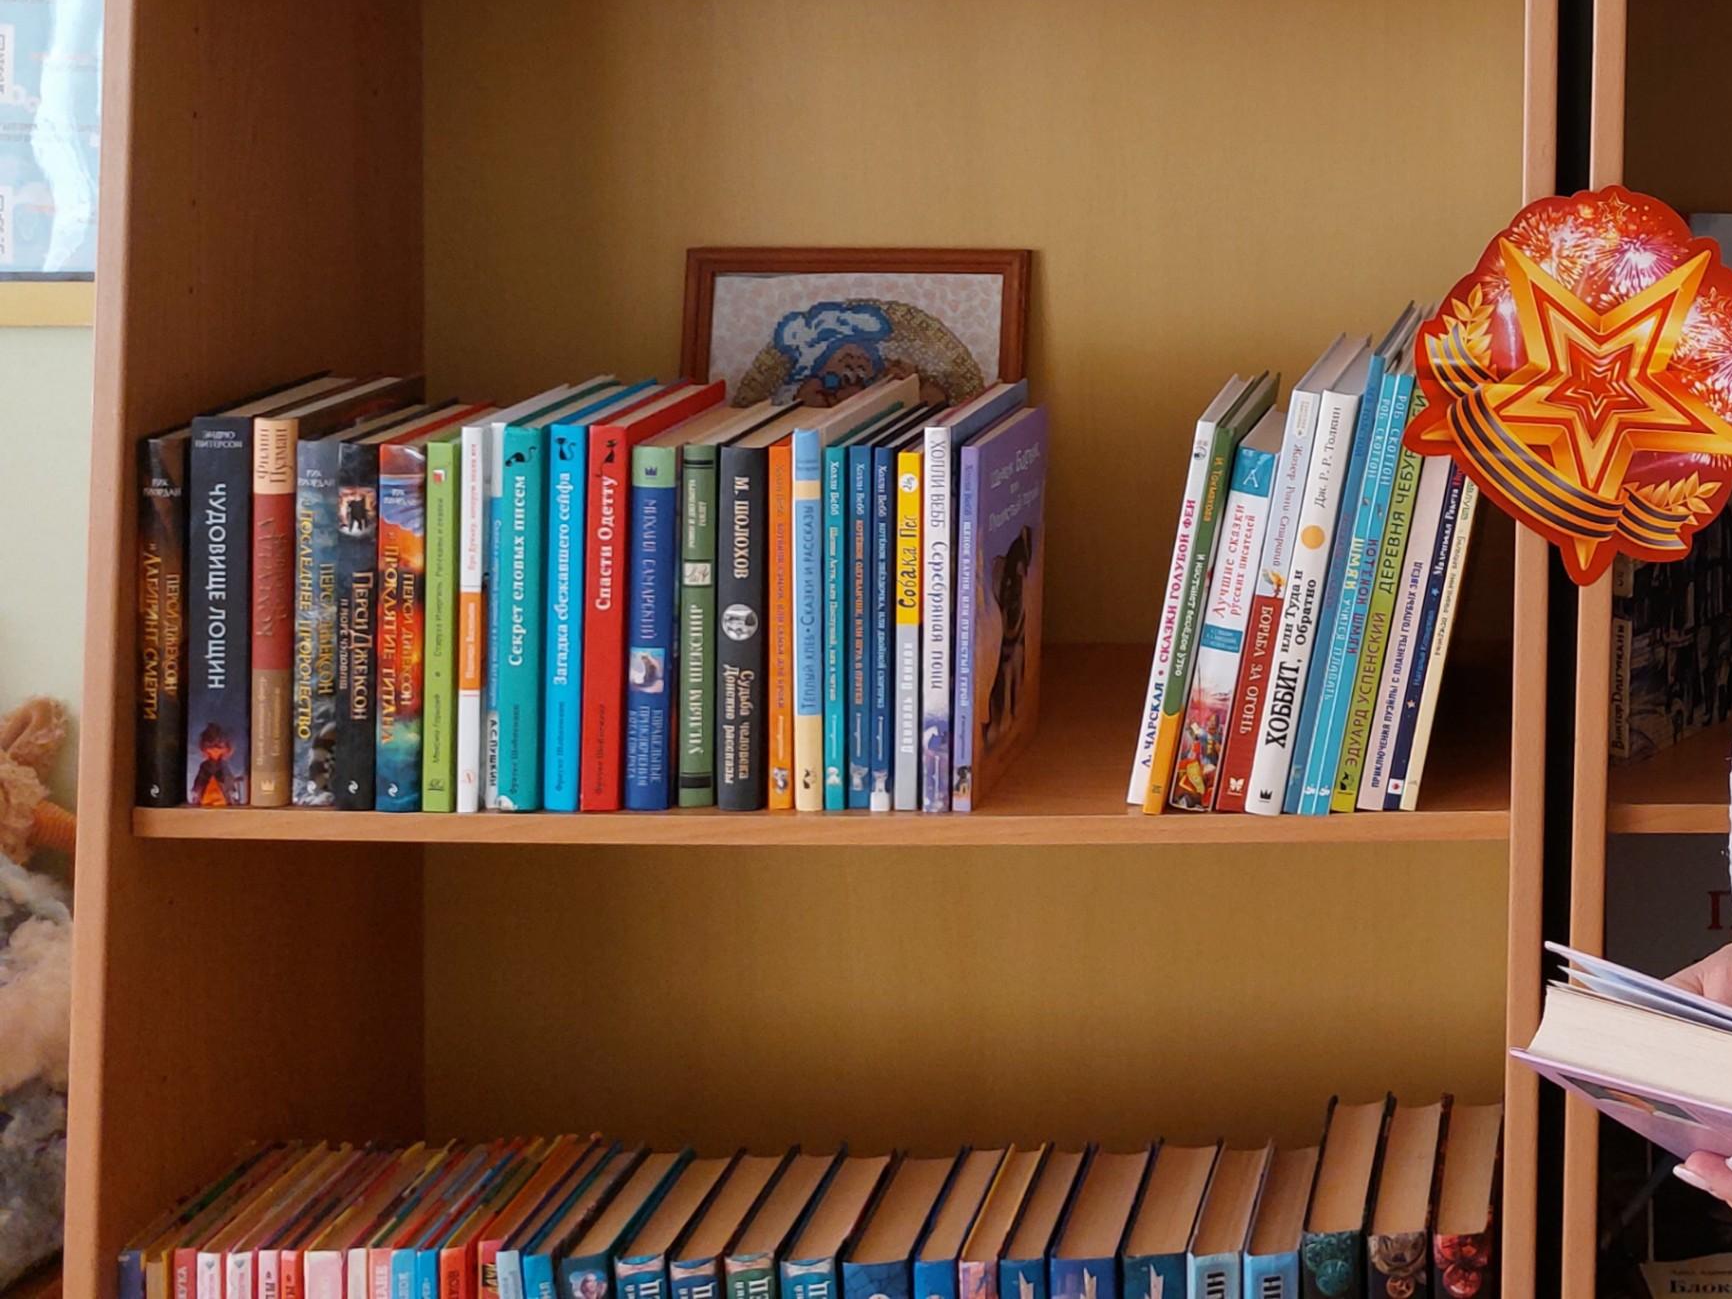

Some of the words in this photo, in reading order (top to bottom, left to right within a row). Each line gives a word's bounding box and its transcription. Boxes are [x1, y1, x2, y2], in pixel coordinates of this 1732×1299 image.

[734, 476, 748, 495] М.
[930, 440, 948, 490] ХОЛЛИ
[510, 475, 526, 532] писем
[554, 472, 573, 521] сейфа
[596, 475, 617, 542] Одетту
[930, 493, 946, 528] ВЕББ
[205, 482, 227, 601] ЧУДОВИЩЕ
[509, 535, 525, 602] еловых
[734, 499, 748, 580] ШОЛОХОВ
[1212, 556, 1239, 620] Лучшие
[1229, 503, 1246, 554] сказки
[1237, 514, 1257, 570] писателей
[1378, 510, 1407, 595] ДЕРЕВНЯ
[554, 524, 573, 621] сбежавшего
[595, 544, 613, 611] Спасти
[896, 547, 918, 609] Собака
[927, 540, 950, 642] Серебряная
[1158, 604, 1178, 664] СКАЗКИ
[1168, 533, 1192, 600] ГОЛУБОЙ
[1182, 498, 1197, 530] ФЕИ
[1230, 572, 1248, 617] русских
[507, 604, 526, 667] Секрет
[1251, 605, 1275, 657] БОРЬБА
[1293, 578, 1318, 647] Обратно
[203, 606, 227, 689] ЛОЩИН
[553, 624, 571, 686] Загадка
[1250, 663, 1263, 682] ЗА
[1356, 611, 1387, 705] УСПЕНСКИЙ
[722, 664, 738, 720] Донские
[737, 669, 755, 717] Судьба
[1239, 685, 1260, 735] ОГОНЬ
[1265, 658, 1302, 748] ХОББИТ,
[721, 724, 736, 784] рассказы
[737, 722, 751, 781] человека
[1345, 708, 1369, 768] ЭДУАРД
